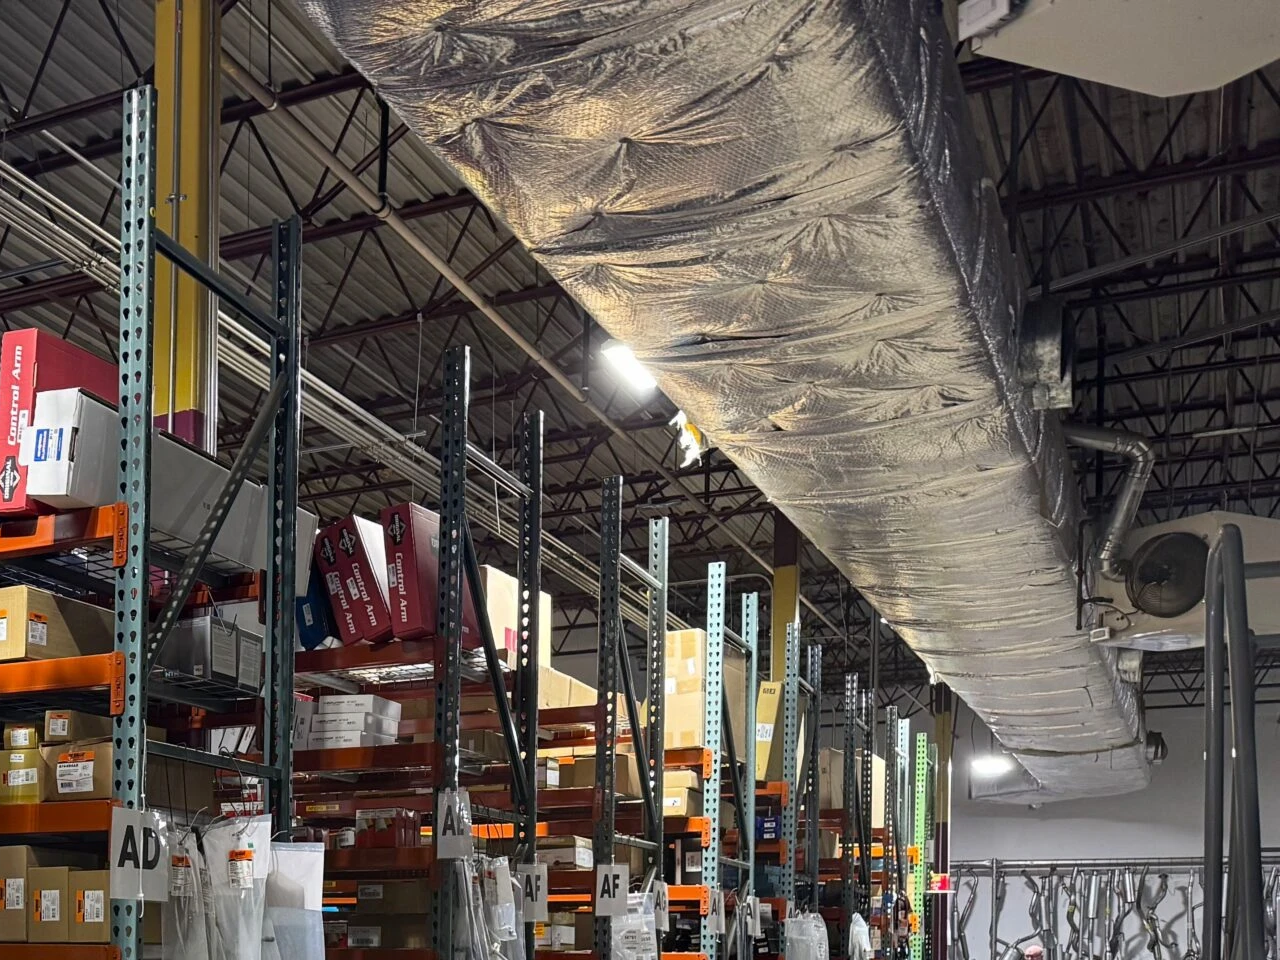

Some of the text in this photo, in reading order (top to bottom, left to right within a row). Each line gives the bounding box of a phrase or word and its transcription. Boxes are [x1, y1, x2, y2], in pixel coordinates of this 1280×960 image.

[8, 345, 23, 446] Control Arm
[351, 562, 378, 627] Control Arm
[396, 552, 408, 623] Control Arm
[344, 611, 357, 635] Arm
[117, 824, 161, 869] AD
[524, 873, 541, 902] AF
[600, 873, 620, 899] AF
